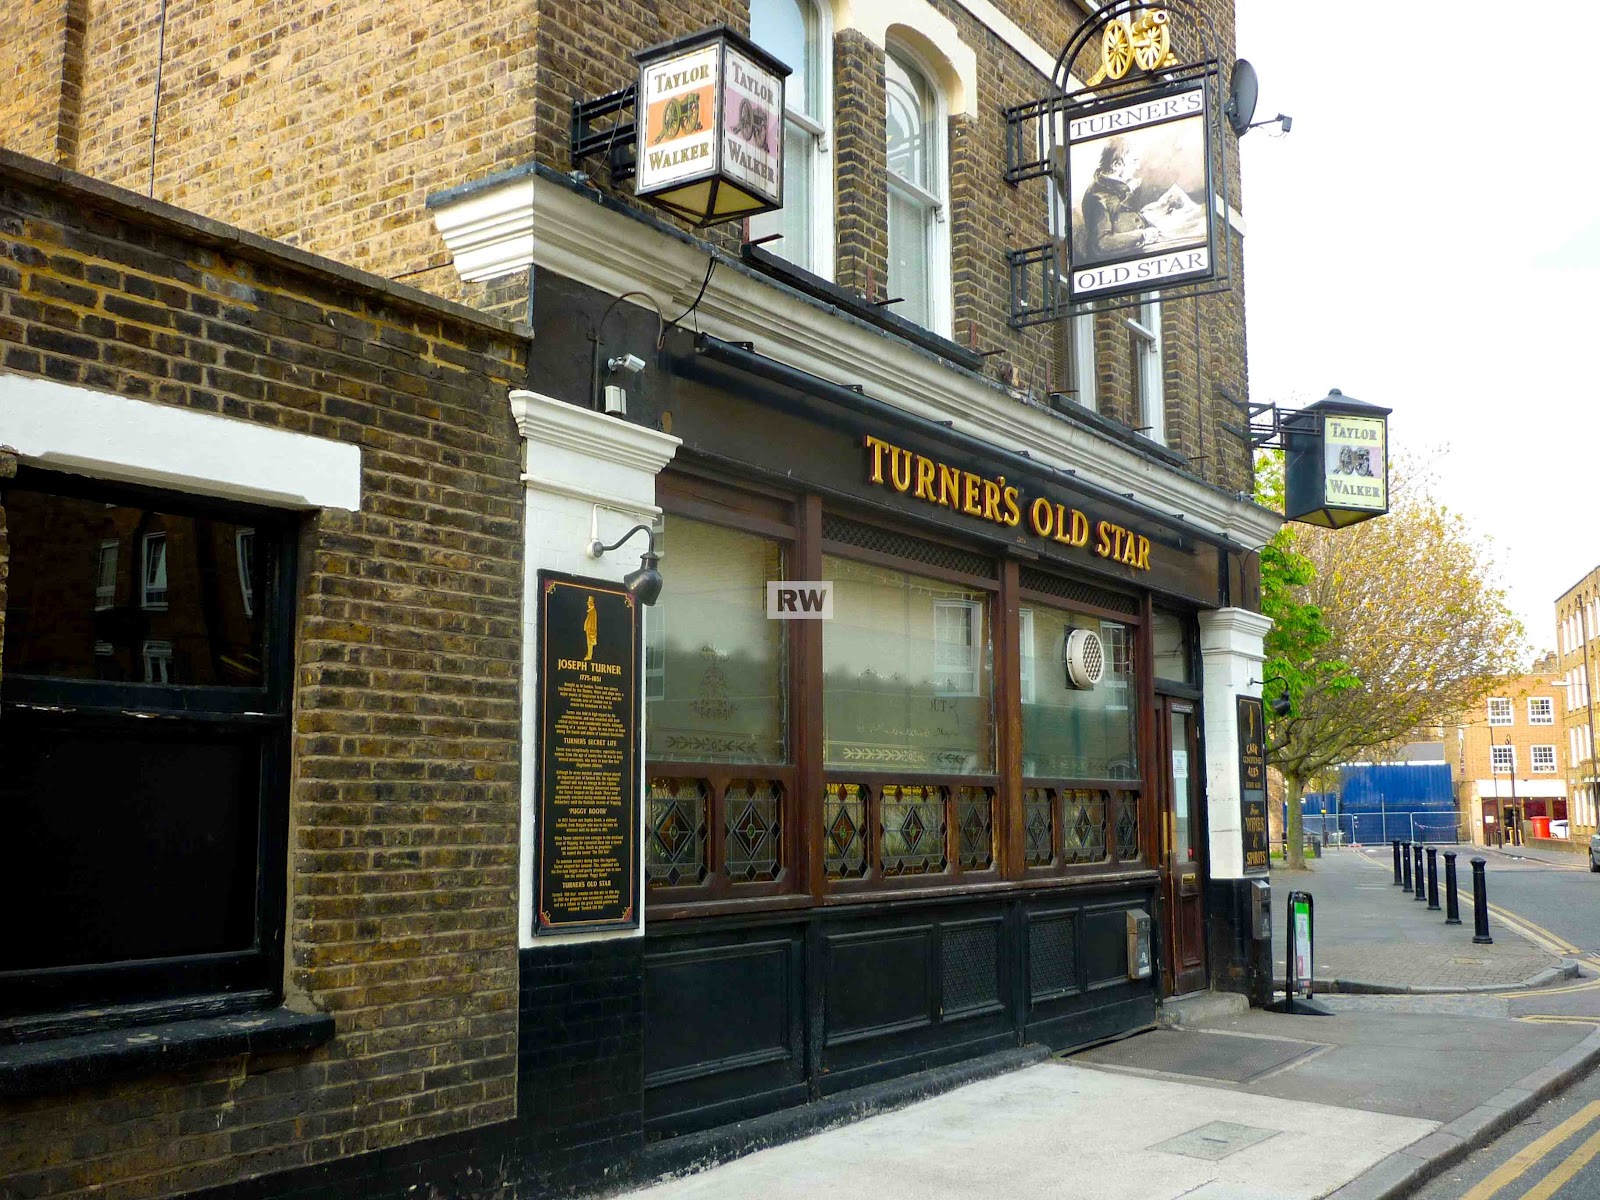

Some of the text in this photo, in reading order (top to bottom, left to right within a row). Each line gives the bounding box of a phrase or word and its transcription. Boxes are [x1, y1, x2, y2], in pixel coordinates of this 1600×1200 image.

[655, 64, 710, 93] TAYLOR
[731, 61, 775, 106] TAYLOR
[1071, 93, 1201, 137] TURNER'S
[649, 142, 709, 172] WALKER
[728, 138, 775, 184] WALKER
[1078, 252, 1206, 289] OLD STAR
[1330, 422, 1377, 440] TAYLOR
[865, 435, 1150, 571] TURNER'S OLD STAR
[1329, 479, 1380, 498] WALKER
[558, 658, 622, 675] JOSEPH TURNER
[563, 737, 617, 747] TURNER'S SECRET LIFE
